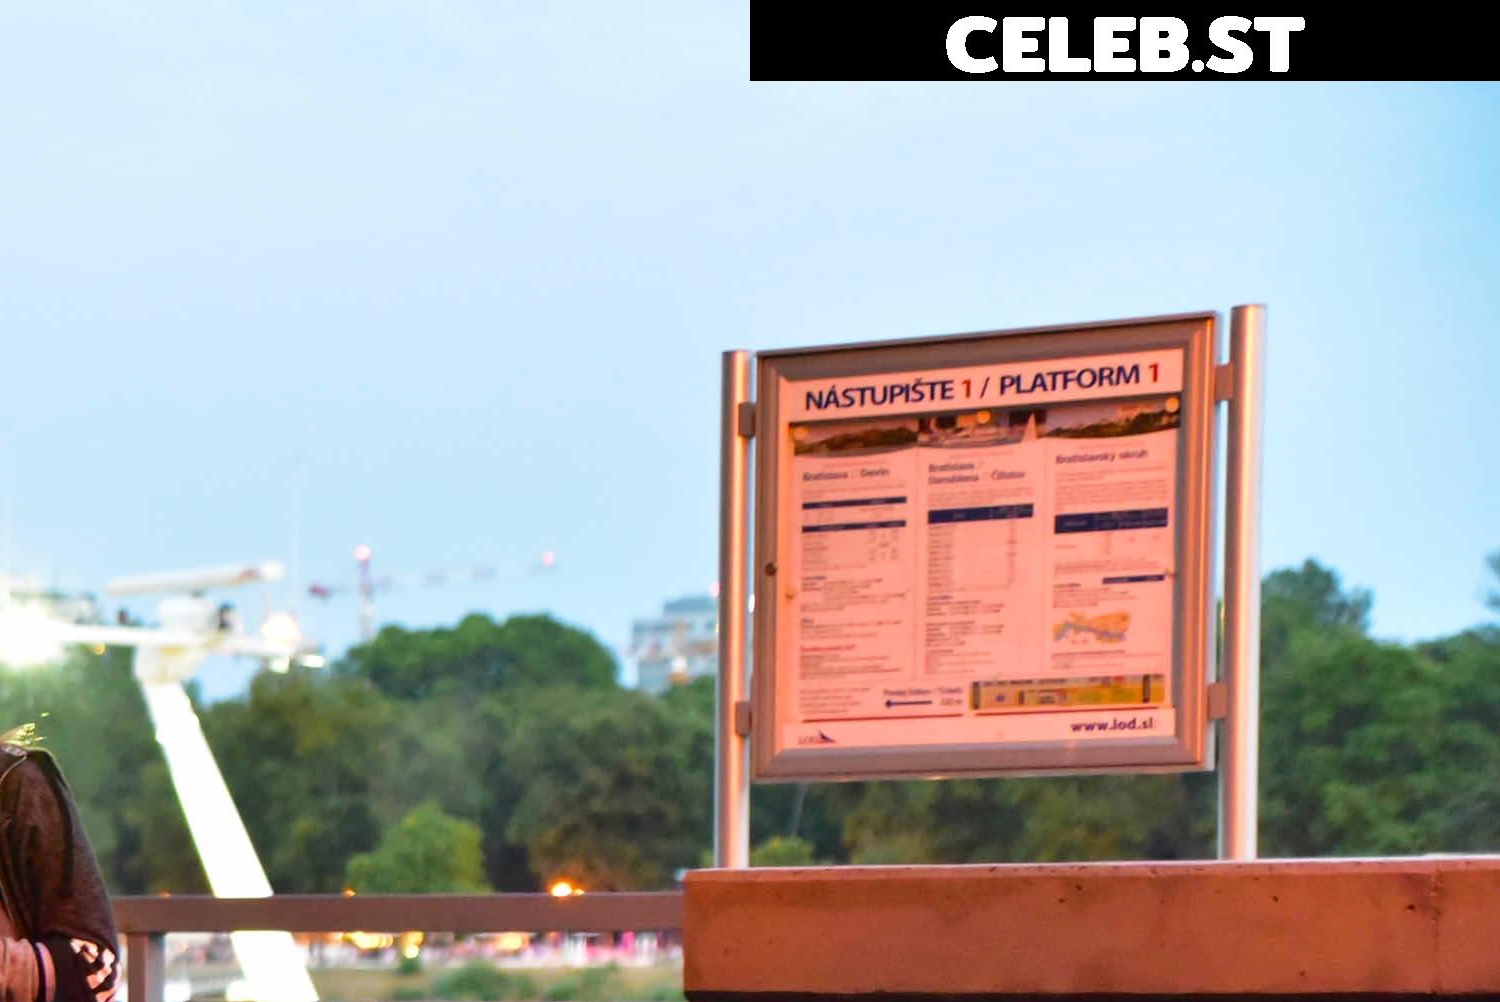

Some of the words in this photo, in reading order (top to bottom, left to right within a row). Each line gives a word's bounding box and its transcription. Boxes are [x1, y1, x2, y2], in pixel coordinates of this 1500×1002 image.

[805, 377, 955, 411] NÁSTUPIŠTE
[962, 379, 972, 399] 1
[1000, 364, 1141, 396] PLATFORM
[1148, 363, 1159, 383] 1
